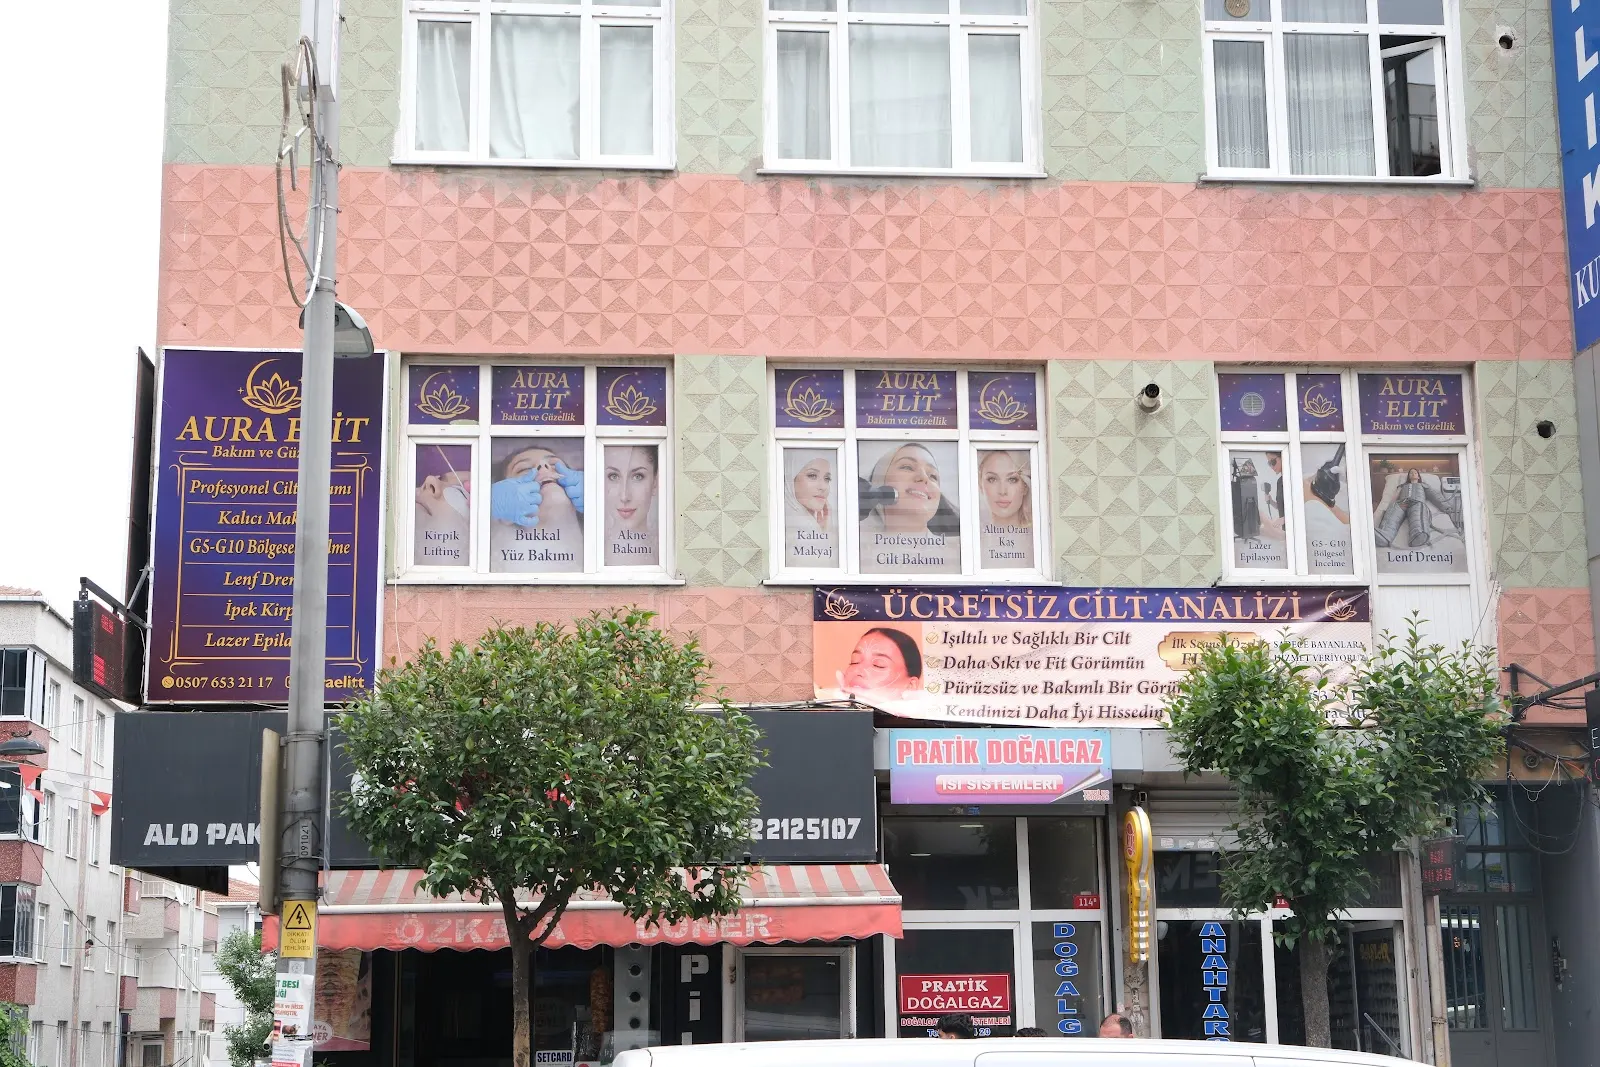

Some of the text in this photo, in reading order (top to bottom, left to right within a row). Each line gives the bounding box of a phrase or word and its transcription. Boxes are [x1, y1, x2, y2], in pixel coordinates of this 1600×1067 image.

[511, 372, 570, 389] AURA
[876, 371, 941, 390] AURA
[1379, 379, 1446, 396] AURA
[515, 389, 567, 410] ELİT
[881, 391, 938, 413] ELİT
[1385, 396, 1444, 418] ELİT
[502, 413, 528, 422] Bakım
[541, 412, 576, 423] Güzellik
[867, 415, 947, 427] Bakım ve Güzellik
[175, 411, 370, 443] AURA EİT
[1372, 421, 1402, 431] Bakım
[1416, 421, 1456, 432] Güzellik
[212, 445, 256, 458] Bakım
[258, 448, 274, 459] ve
[190, 479, 269, 498] Profesyonel
[273, 480, 299, 495] Cilt
[218, 510, 298, 526] Kalıcı Mak
[424, 530, 460, 544] Kirpik
[515, 528, 561, 541] Bukkal
[617, 529, 647, 541] Akne
[797, 530, 829, 541] Kalıcı
[984, 524, 1029, 535] Altın Oran
[875, 533, 946, 548] Profesyonel
[999, 537, 1015, 549] Kaş
[1248, 541, 1272, 550] Lazer
[1311, 539, 1323, 548] G5
[1329, 539, 1346, 548] G10
[190, 538, 296, 560] G5-G10 Bölgese
[423, 546, 460, 559] Lifting
[501, 548, 574, 562] Yüz Bakımı
[613, 543, 652, 555] Bakımı
[793, 546, 832, 559] Makyaj
[988, 549, 1026, 560] Tasarımı
[876, 553, 945, 566] Cilt Bakımı
[1240, 552, 1281, 563] Epilasyon
[1387, 550, 1453, 565] Lenf Drenaj
[223, 571, 295, 591] Lenf Dren
[224, 599, 294, 622] İpek Kirp
[881, 588, 1303, 621] ÜCRETSİZ CİLT ANALİZİ
[204, 633, 293, 652] Lazer Epila
[942, 631, 1132, 649] Işıltılı ve Sağlıklı Bir Cilt
[1171, 636, 1187, 649] İlk
[943, 655, 1145, 671] Daha Sıkı ve Fit Görümün
[175, 675, 365, 689] 0507 653 21 17 aelitt
[943, 680, 1183, 695] Pürüzsüz ve Bakımlı Bir Görü
[944, 702, 1164, 722] Kendinizi Daha İyi Hissedin
[896, 735, 1103, 766] PRATİK DOĞALGAZ
[941, 779, 963, 791] ISI
[143, 822, 261, 846] ALO PAK
[767, 817, 861, 840] 2125107
[396, 914, 566, 944] ÖZKAA
[282, 979, 300, 988] BESİ
[921, 978, 988, 993] PRATİK
[1053, 923, 1082, 1034] DOĞALG
[1199, 922, 1231, 1042] ANAHTAR
[907, 994, 1004, 1010] DOĞALGAZ
[971, 1015, 1011, 1026] STEMLERİ
[537, 1051, 572, 1062] SETCARD
